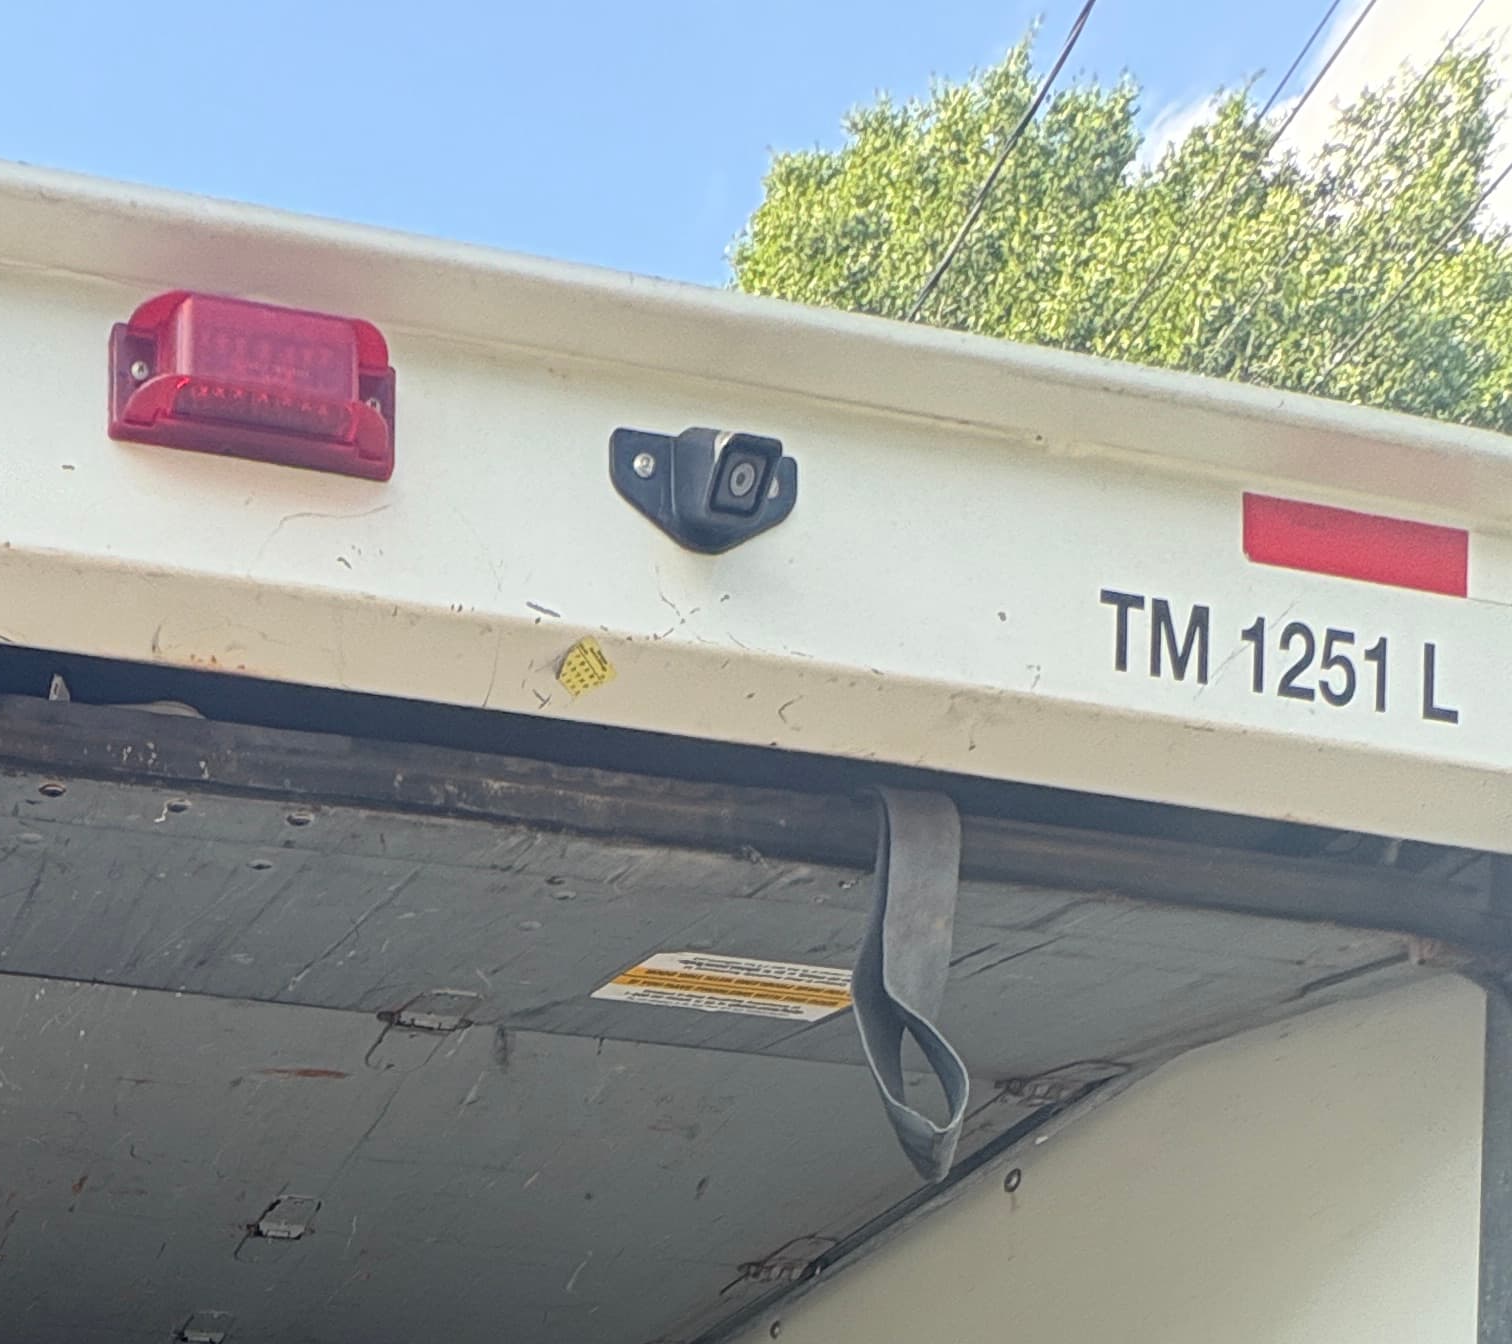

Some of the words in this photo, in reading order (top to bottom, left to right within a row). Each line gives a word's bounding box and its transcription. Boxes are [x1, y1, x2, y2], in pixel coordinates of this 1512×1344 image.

[1100, 588, 1211, 685] TM
[1241, 615, 1388, 713] 1251
[1422, 642, 1460, 725] L
